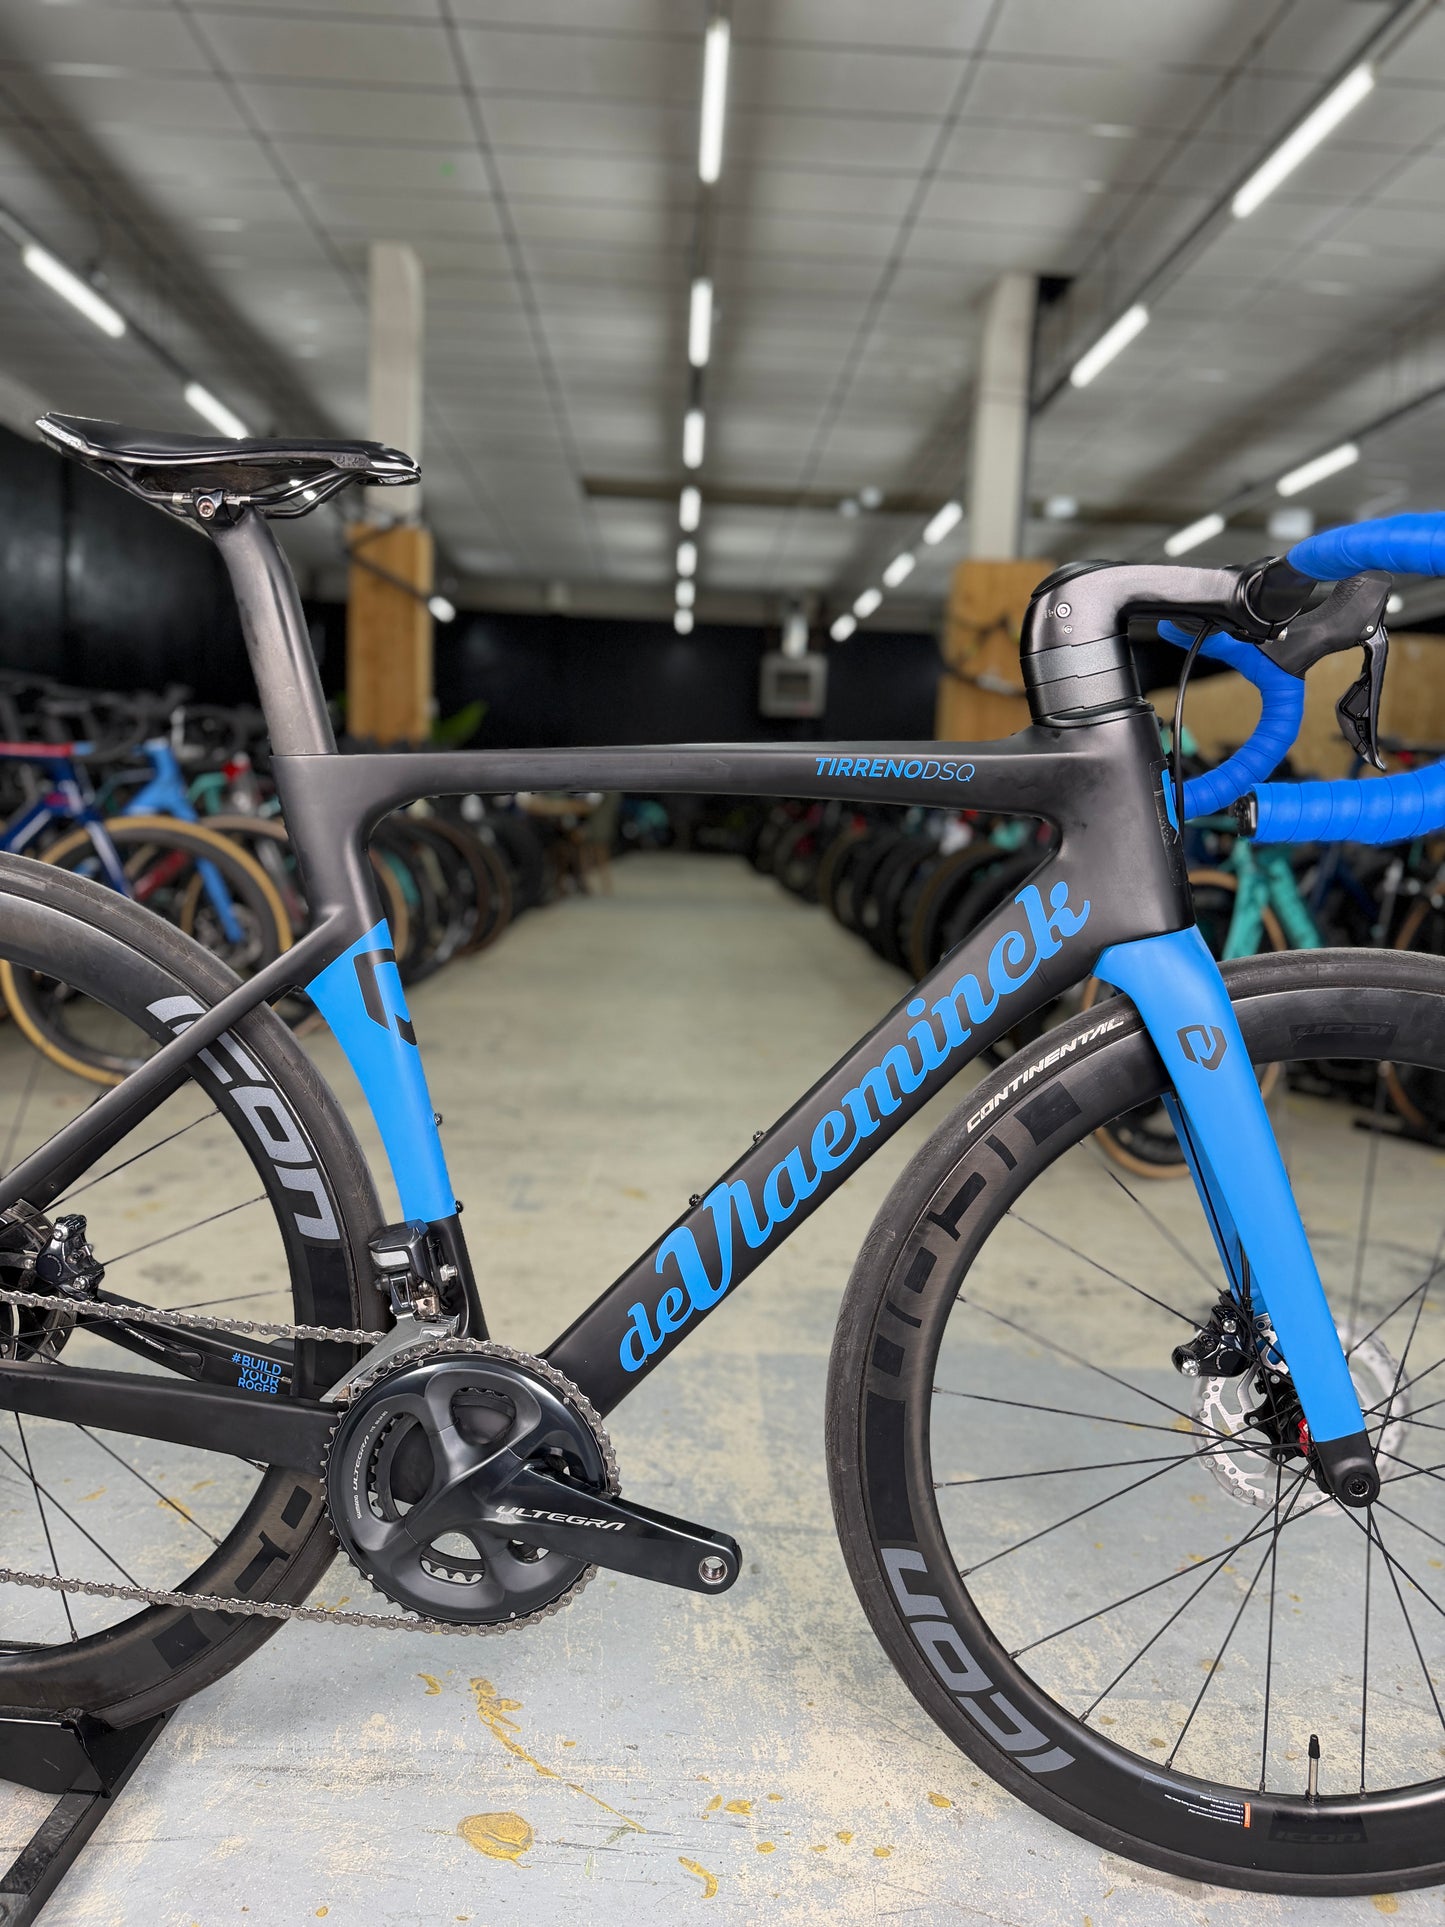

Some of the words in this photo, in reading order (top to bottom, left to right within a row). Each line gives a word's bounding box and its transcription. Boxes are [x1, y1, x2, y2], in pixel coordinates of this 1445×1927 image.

[967, 1017, 1125, 1134] CONTINENTAL
[231, 1352, 282, 1376] #BUILD
[241, 1366, 279, 1388] YOUR
[352, 1435, 370, 1491] ULTEGRA
[495, 1505, 627, 1531] ULTEGRA
